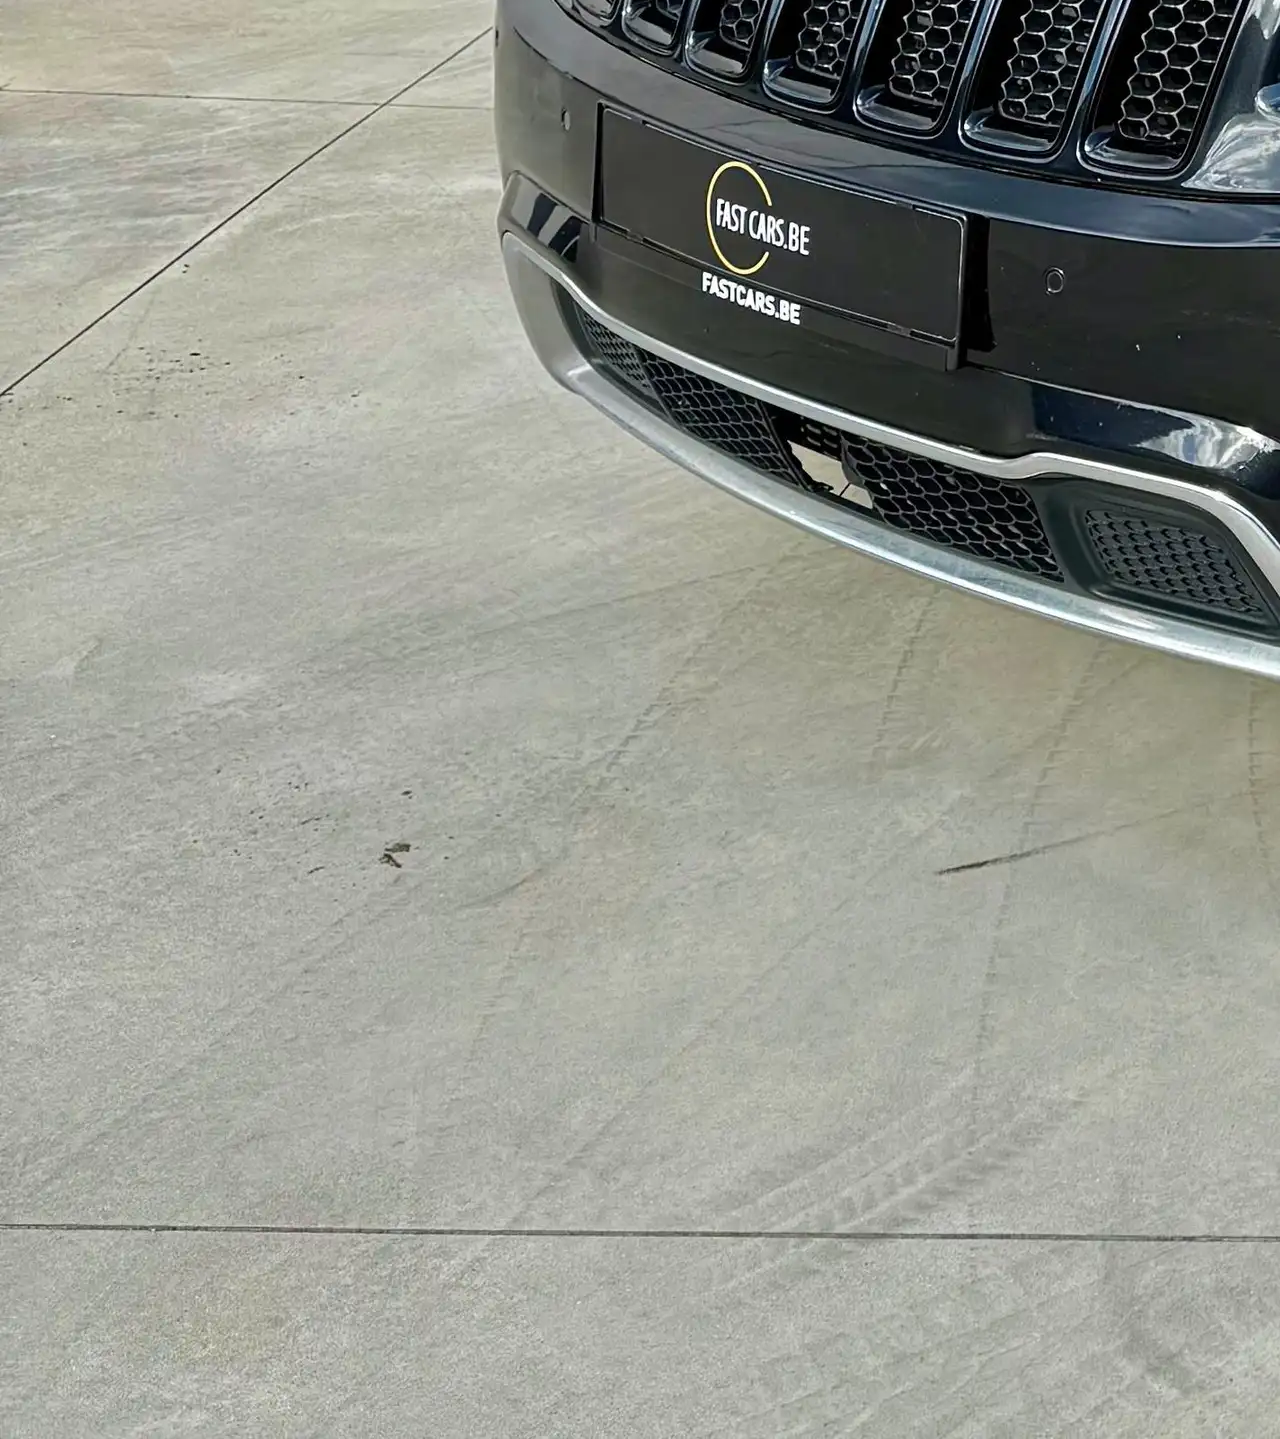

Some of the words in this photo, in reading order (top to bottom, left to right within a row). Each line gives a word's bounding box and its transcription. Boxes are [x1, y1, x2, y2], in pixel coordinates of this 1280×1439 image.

[716, 198, 748, 235] FAST
[749, 210, 811, 255] CARS.BE
[702, 271, 800, 325] FASTCARS.BE
